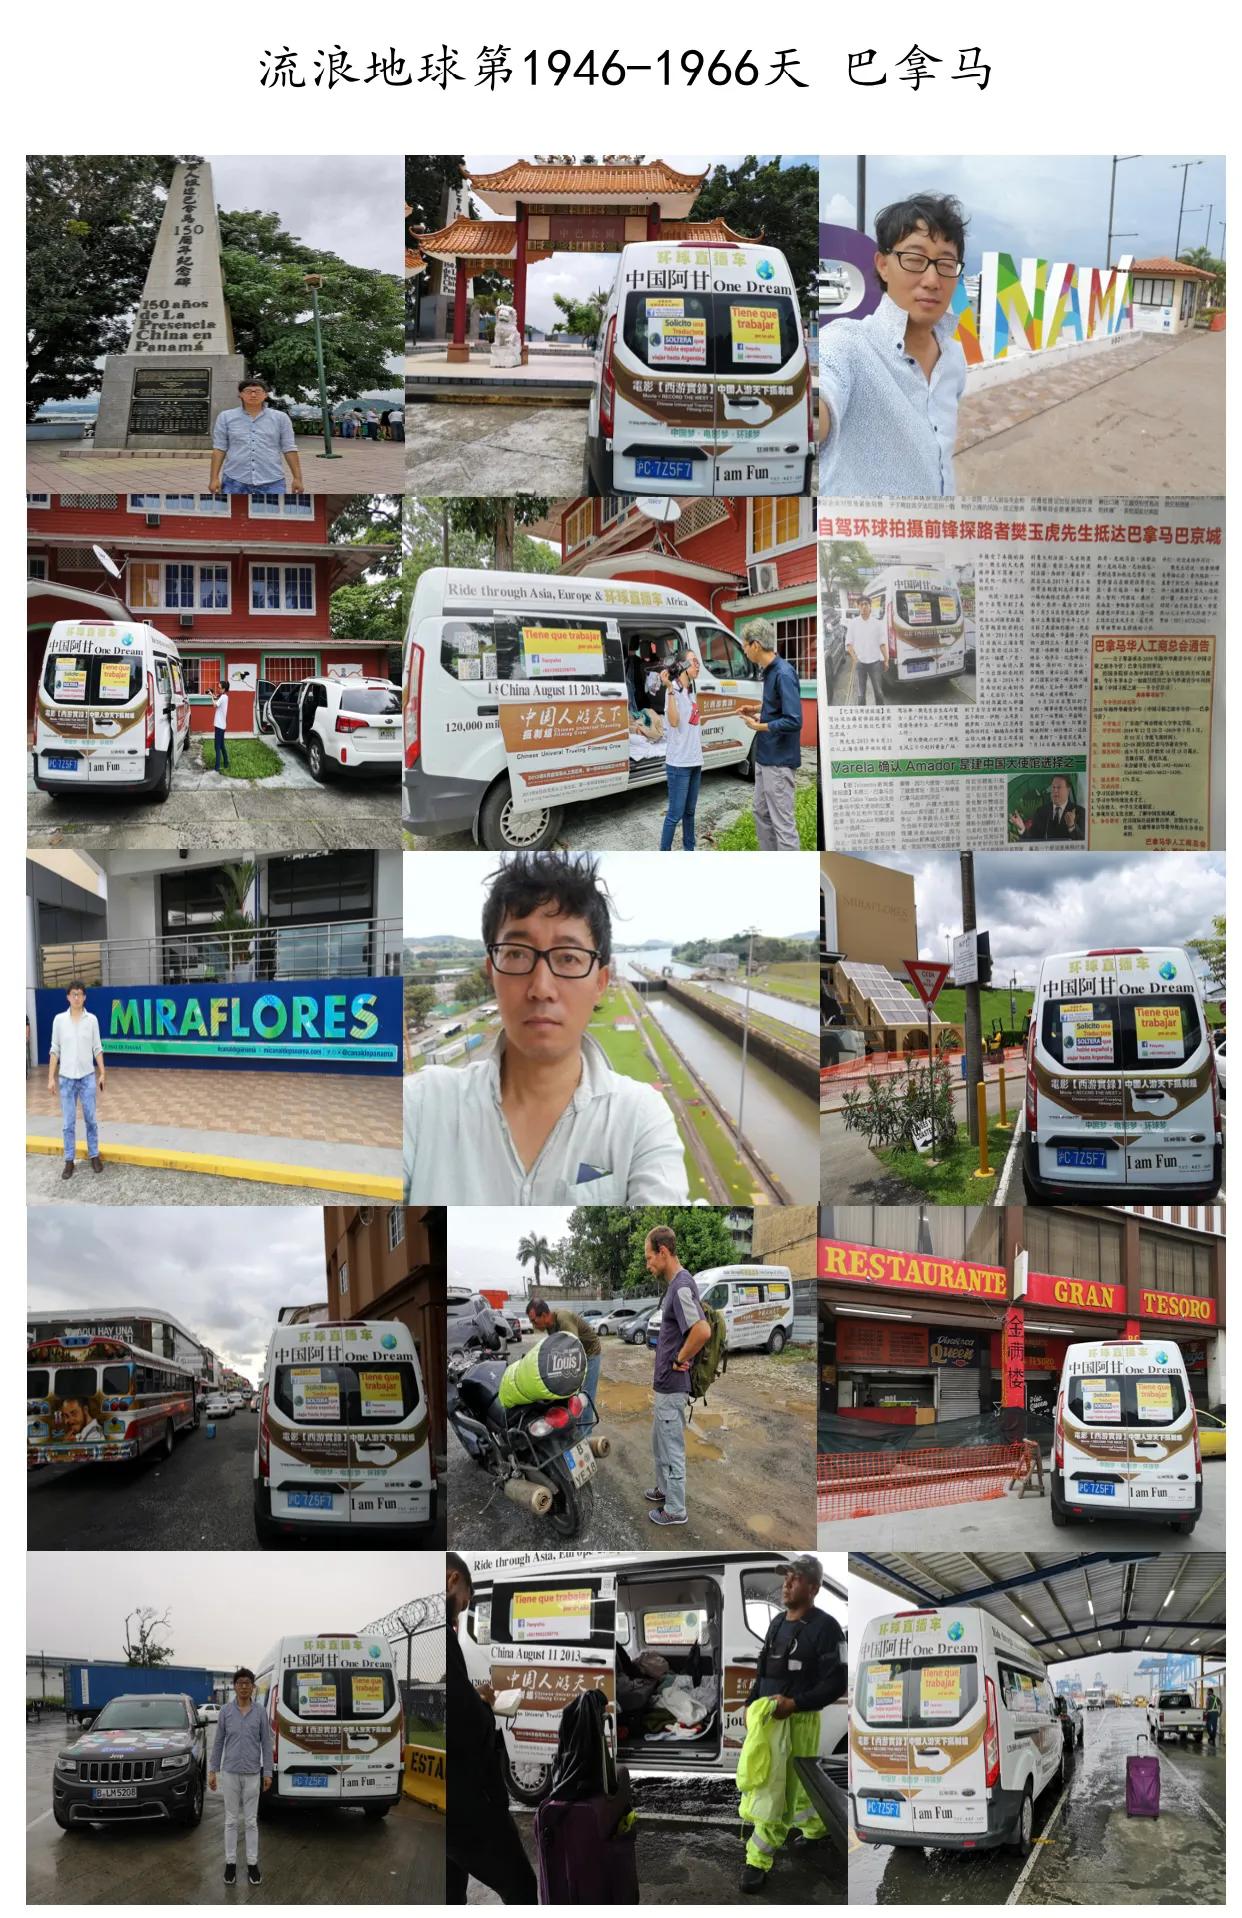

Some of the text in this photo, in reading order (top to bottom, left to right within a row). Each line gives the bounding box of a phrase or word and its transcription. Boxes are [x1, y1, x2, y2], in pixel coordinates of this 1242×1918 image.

[626, 269, 793, 296] 中国阿甘 One Dream
[142, 299, 209, 310] 150 años
[139, 309, 185, 320] de La
[732, 307, 777, 320] Tiene que
[138, 319, 217, 330] Presencia
[737, 319, 775, 332] trabajar
[135, 329, 213, 341] China en
[665, 336, 692, 344] SOLTERA
[134, 340, 204, 352] Panamá
[715, 466, 720, 481] I
[723, 468, 743, 481] am
[746, 464, 769, 481] Fun
[818, 520, 1222, 546] 自驾环球拍摄前锋探路者樊玉虎先生抵达巴拿马巴京城
[447, 582, 478, 597] Ride
[481, 584, 527, 600] through
[528, 587, 556, 601] Asia,
[557, 589, 593, 604] Europe
[594, 593, 604, 602] &
[665, 595, 688, 607] Africa
[524, 629, 602, 643] Tiene que trabajar
[49, 639, 144, 656] 中国阿甘 One Dream
[1094, 639, 1210, 653] 巴拿马华人工商总会通告
[500, 683, 600, 699] China August 11 2013
[445, 721, 484, 734] 120,000
[701, 725, 725, 738] ourney
[93, 763, 105, 772] am
[106, 761, 121, 772] Fun
[831, 754, 1087, 775] Varela 确认 Amador 是建中国大使馆选择之一
[1042, 976, 1195, 998] 中国阿甘 One Dream
[109, 993, 380, 1040] MIRAFLORES
[1136, 1007, 1180, 1019] Tiene que
[1076, 1022, 1101, 1030] Solicito
[1141, 1017, 1177, 1030] trabajar
[1126, 1153, 1178, 1170] I am Fun
[824, 1246, 1211, 1321] RESTAURANTE GRAN TESORO
[97, 1325, 134, 1336] HAY UNA
[275, 1345, 414, 1364] 中国阿甘 One Dream
[930, 1342, 975, 1364] Queen
[552, 1353, 577, 1372] Louis
[1069, 1360, 1182, 1375] 中国阿甘 One Dream
[360, 1372, 400, 1383] Tiene que
[365, 1381, 397, 1391] trabajar
[575, 1444, 584, 1456] B
[1129, 1486, 1168, 1498] I am Fun
[351, 1497, 397, 1511] I am Fun
[473, 1557, 531, 1571] Ride through
[514, 1594, 538, 1605] Tiene
[538, 1594, 555, 1604] que
[490, 1646, 582, 1661] China August 11 2013
[860, 1637, 979, 1660] 中国阿甘 One Dream
[283, 1653, 393, 1669] 中国阿甘 One Dream
[925, 1679, 956, 1690] trabajar
[342, 1776, 376, 1788] I am Fun
[912, 1805, 954, 1820] I am Fun
